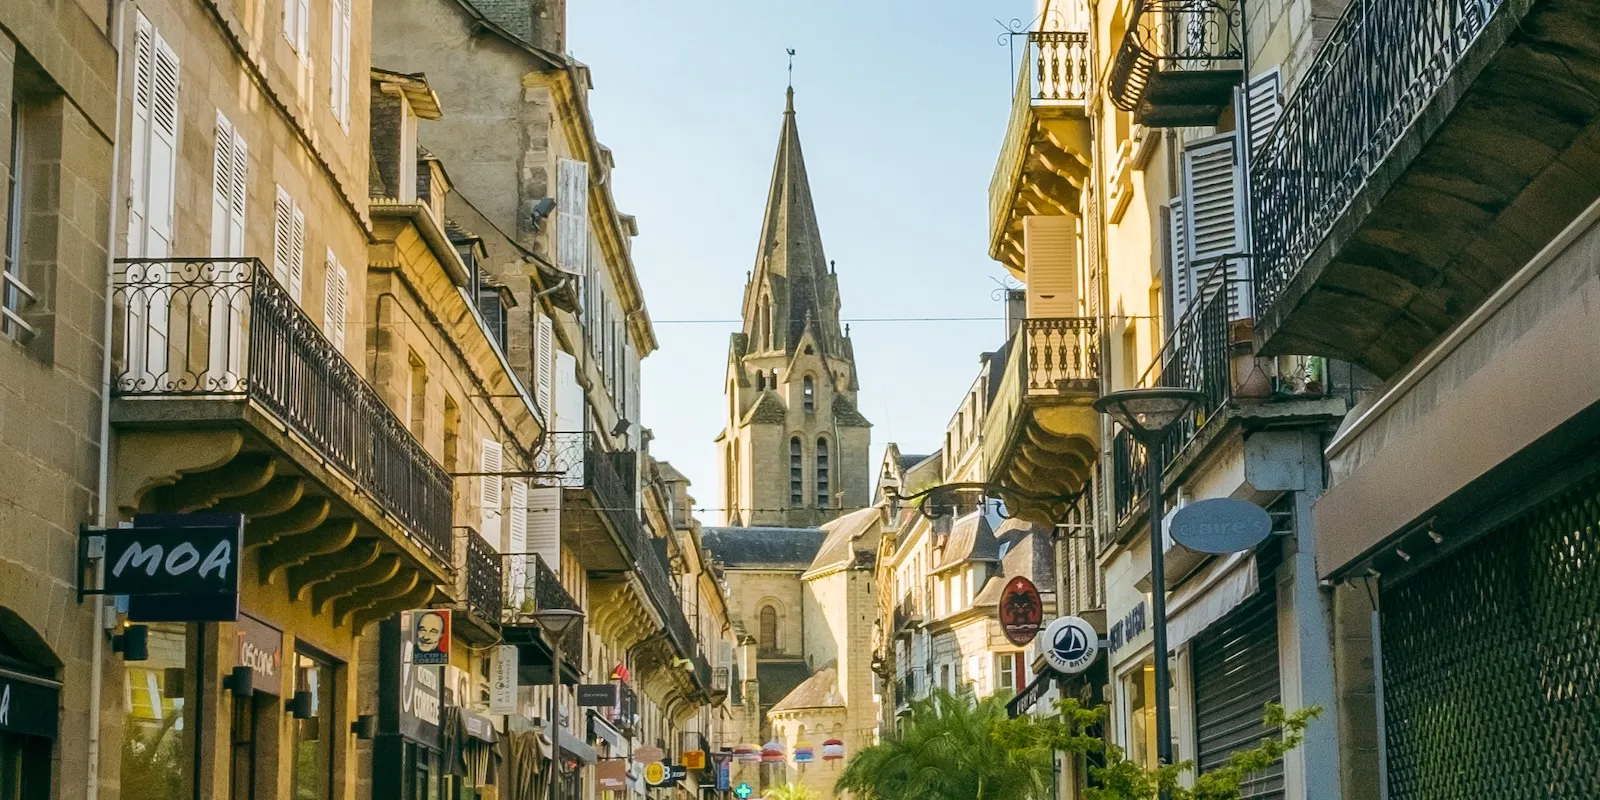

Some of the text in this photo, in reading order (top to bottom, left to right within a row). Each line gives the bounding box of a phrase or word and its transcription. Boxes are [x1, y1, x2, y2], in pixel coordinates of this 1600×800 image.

[112, 539, 231, 579] MOA
[1109, 619, 1123, 654] PETIT
[1048, 647, 1094, 667] PETIT BATEAU
